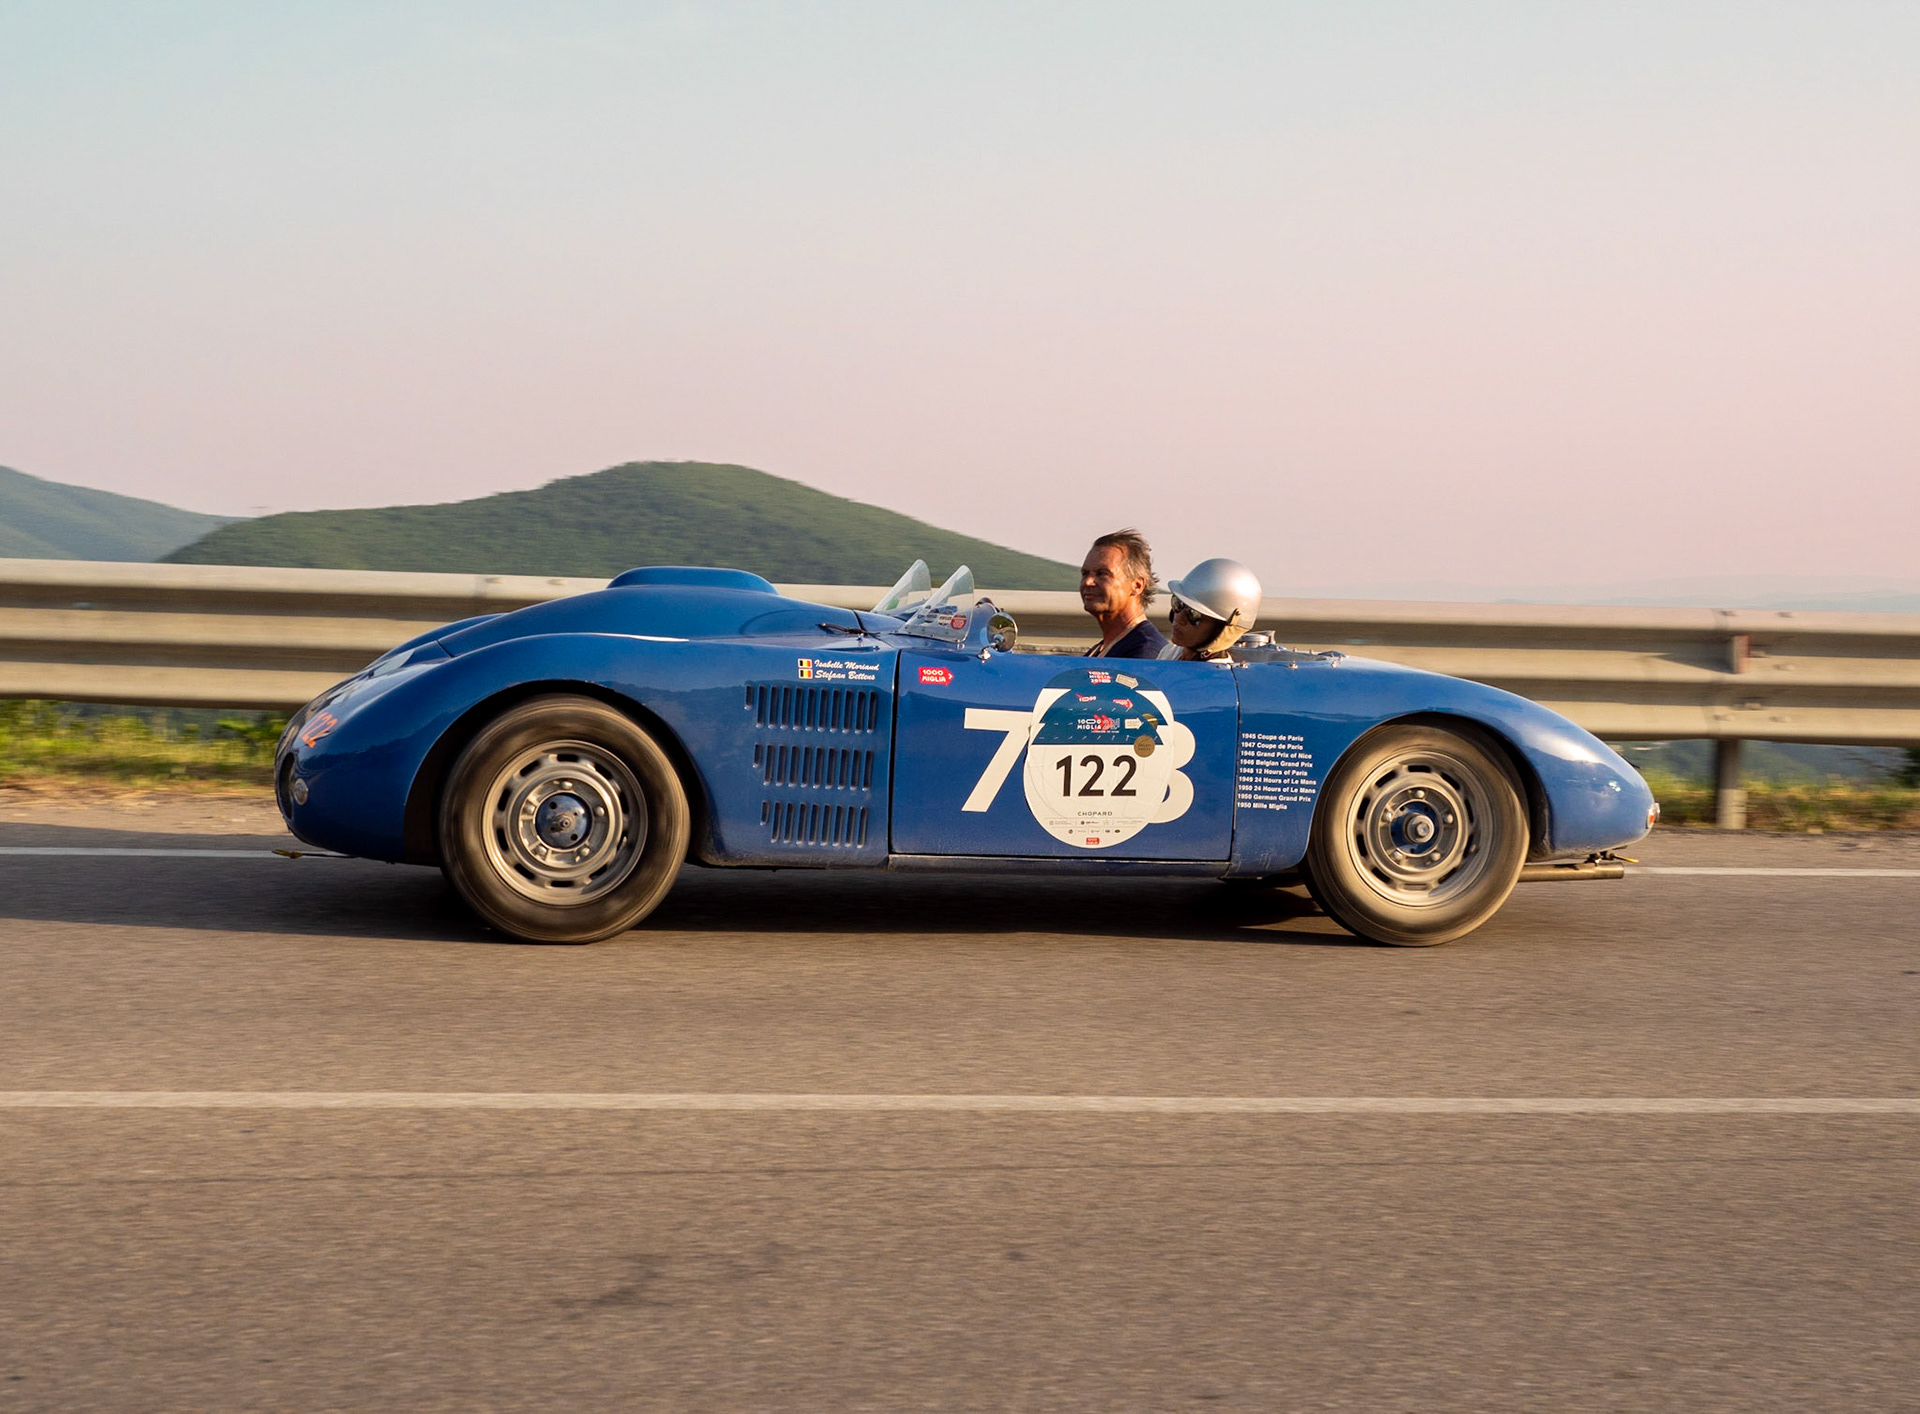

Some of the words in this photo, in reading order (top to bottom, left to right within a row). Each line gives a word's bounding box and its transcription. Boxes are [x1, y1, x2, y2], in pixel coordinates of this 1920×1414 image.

[814, 659, 843, 668] Isabelle
[814, 670, 846, 681] Stefaan
[848, 671, 876, 680] Bettens
[1056, 754, 1137, 797] 122
